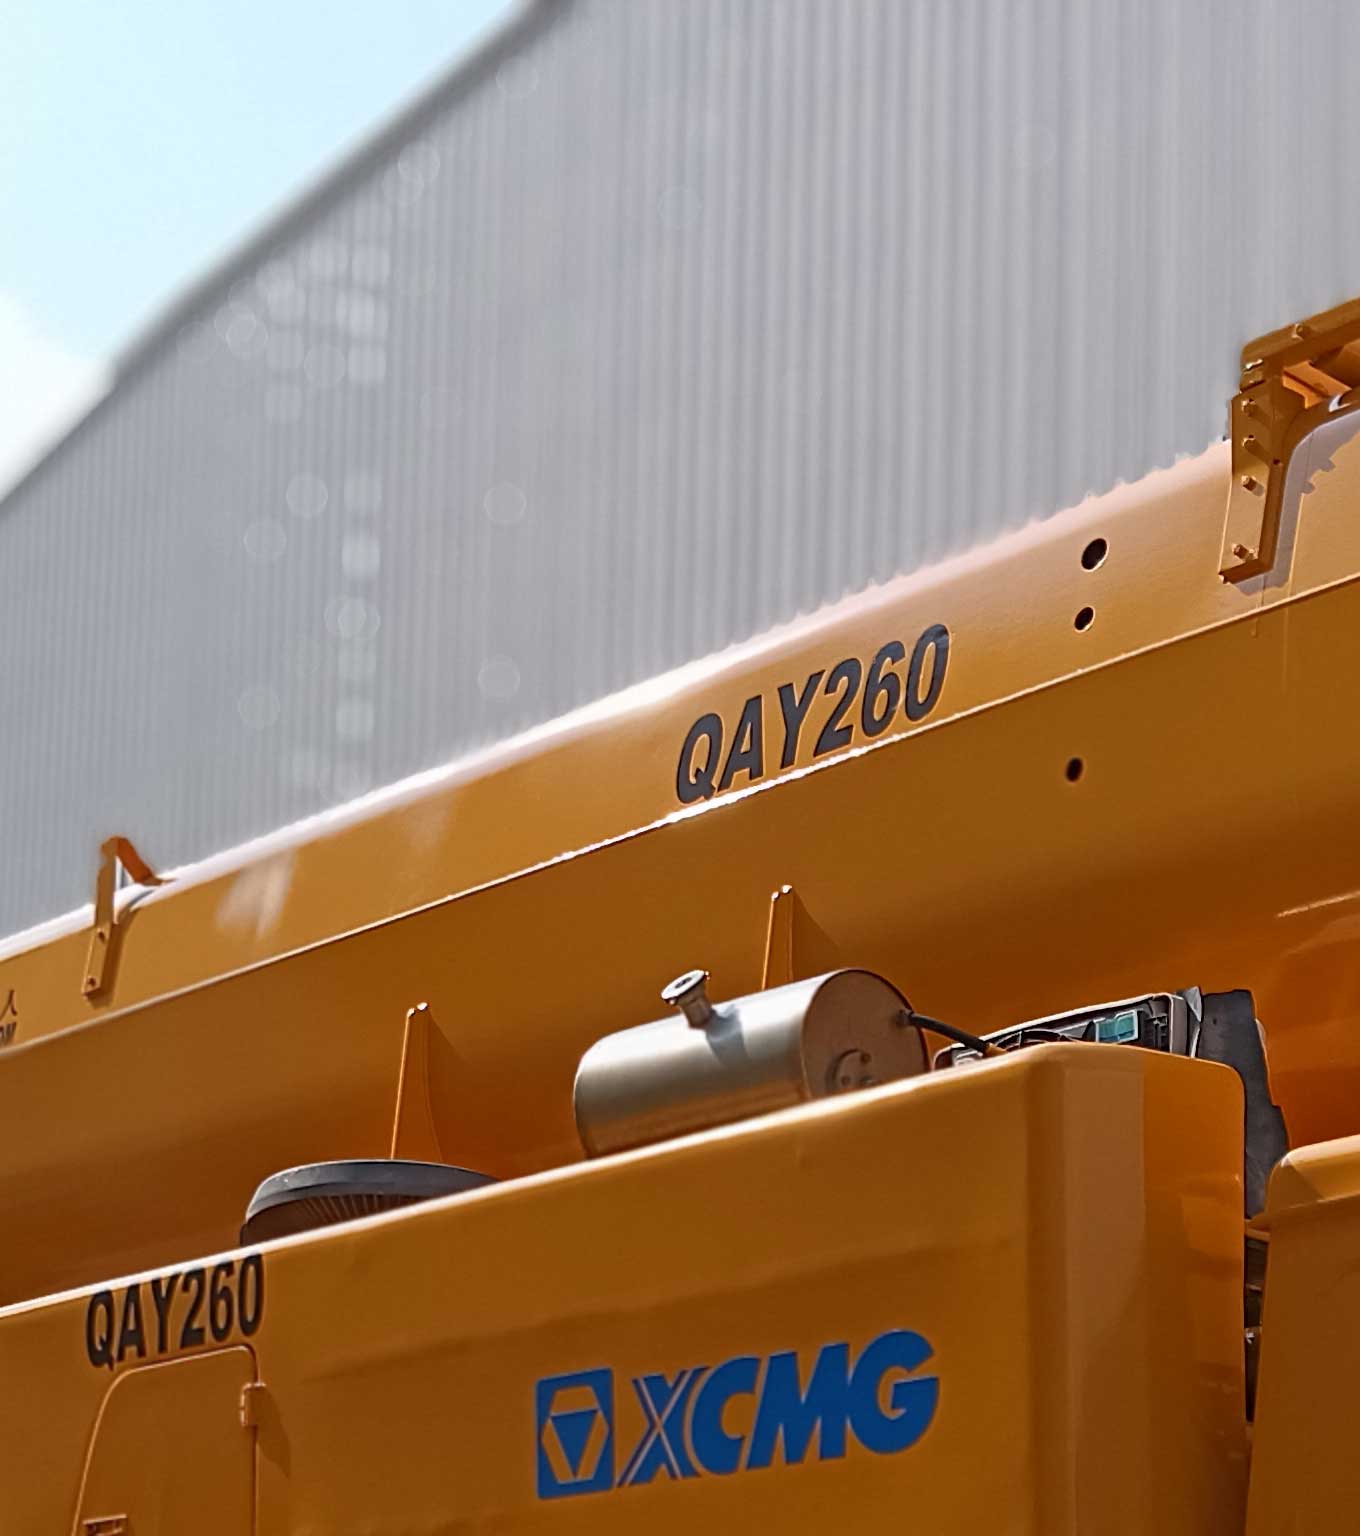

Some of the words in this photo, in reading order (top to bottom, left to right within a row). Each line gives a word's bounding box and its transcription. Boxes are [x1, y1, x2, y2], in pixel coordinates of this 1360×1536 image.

[676, 623, 952, 804] QAY260
[84, 1252, 265, 1370] QAY260
[617, 1329, 941, 1488] XCMG
